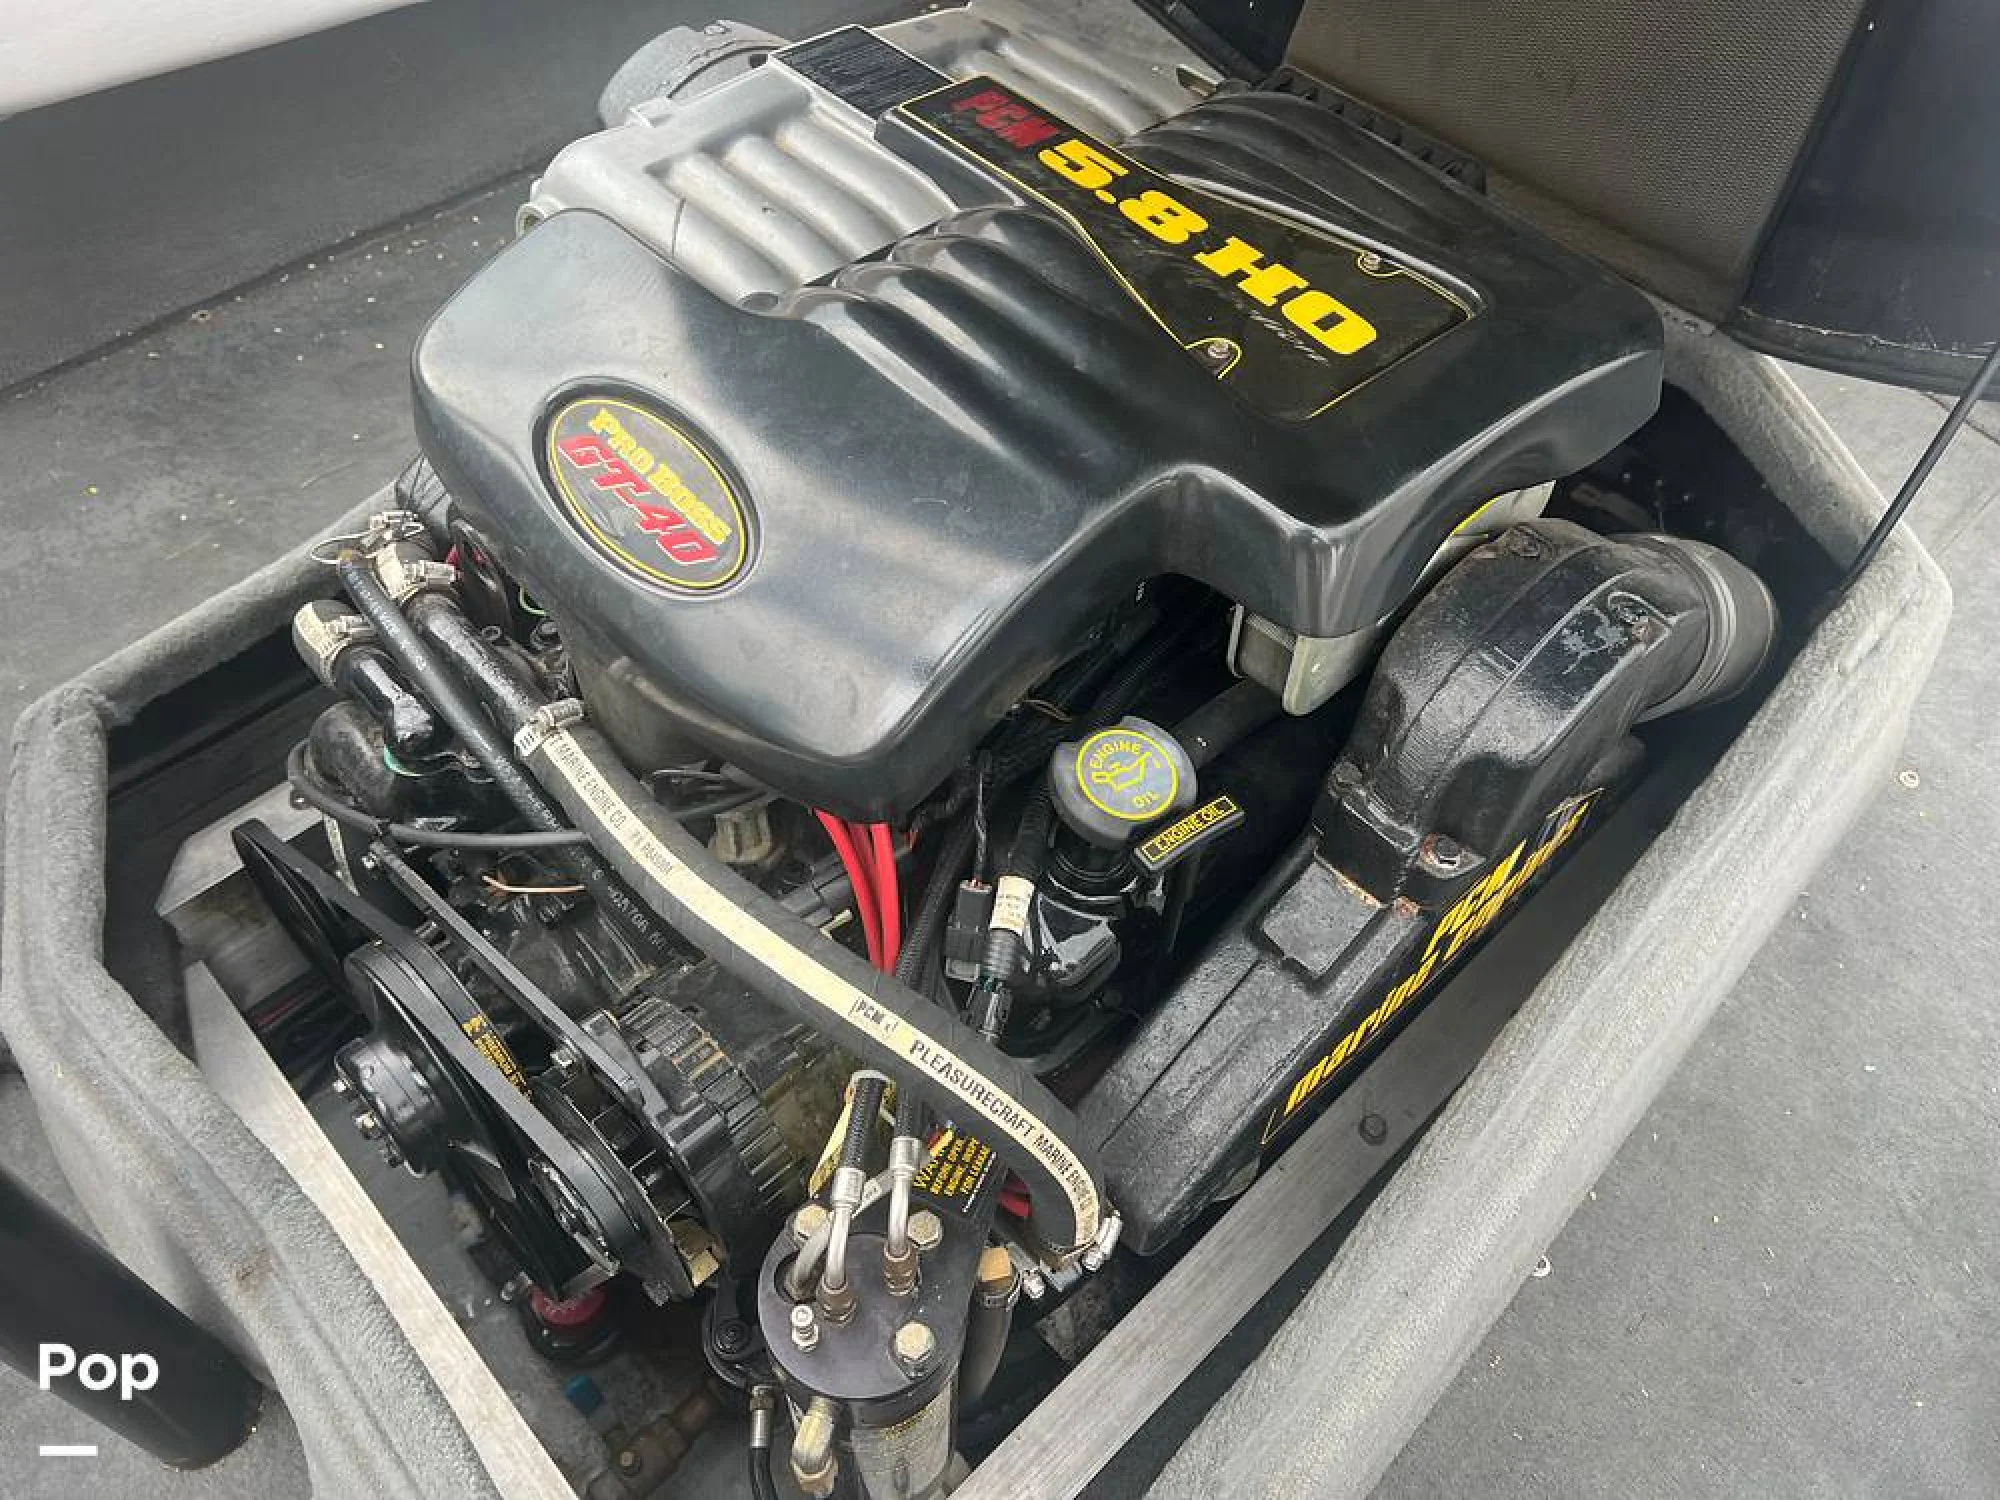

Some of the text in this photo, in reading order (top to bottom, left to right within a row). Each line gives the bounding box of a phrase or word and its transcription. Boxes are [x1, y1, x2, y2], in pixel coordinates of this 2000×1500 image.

[954, 88, 1059, 150] PCM
[1038, 139, 1209, 245] 5.8
[1194, 236, 1378, 356] HO
[558, 435, 721, 565] GT-40
[588, 408, 733, 545] PRO BOSS
[1090, 740, 1141, 769] ENGINE
[1132, 792, 1161, 809] OIL
[1156, 814, 1199, 851] ENGINE
[1421, 838, 1528, 962] PCM
[909, 1039, 1036, 1138] PLEASURECRAFT
[1032, 1134, 1074, 1177] MARINE
